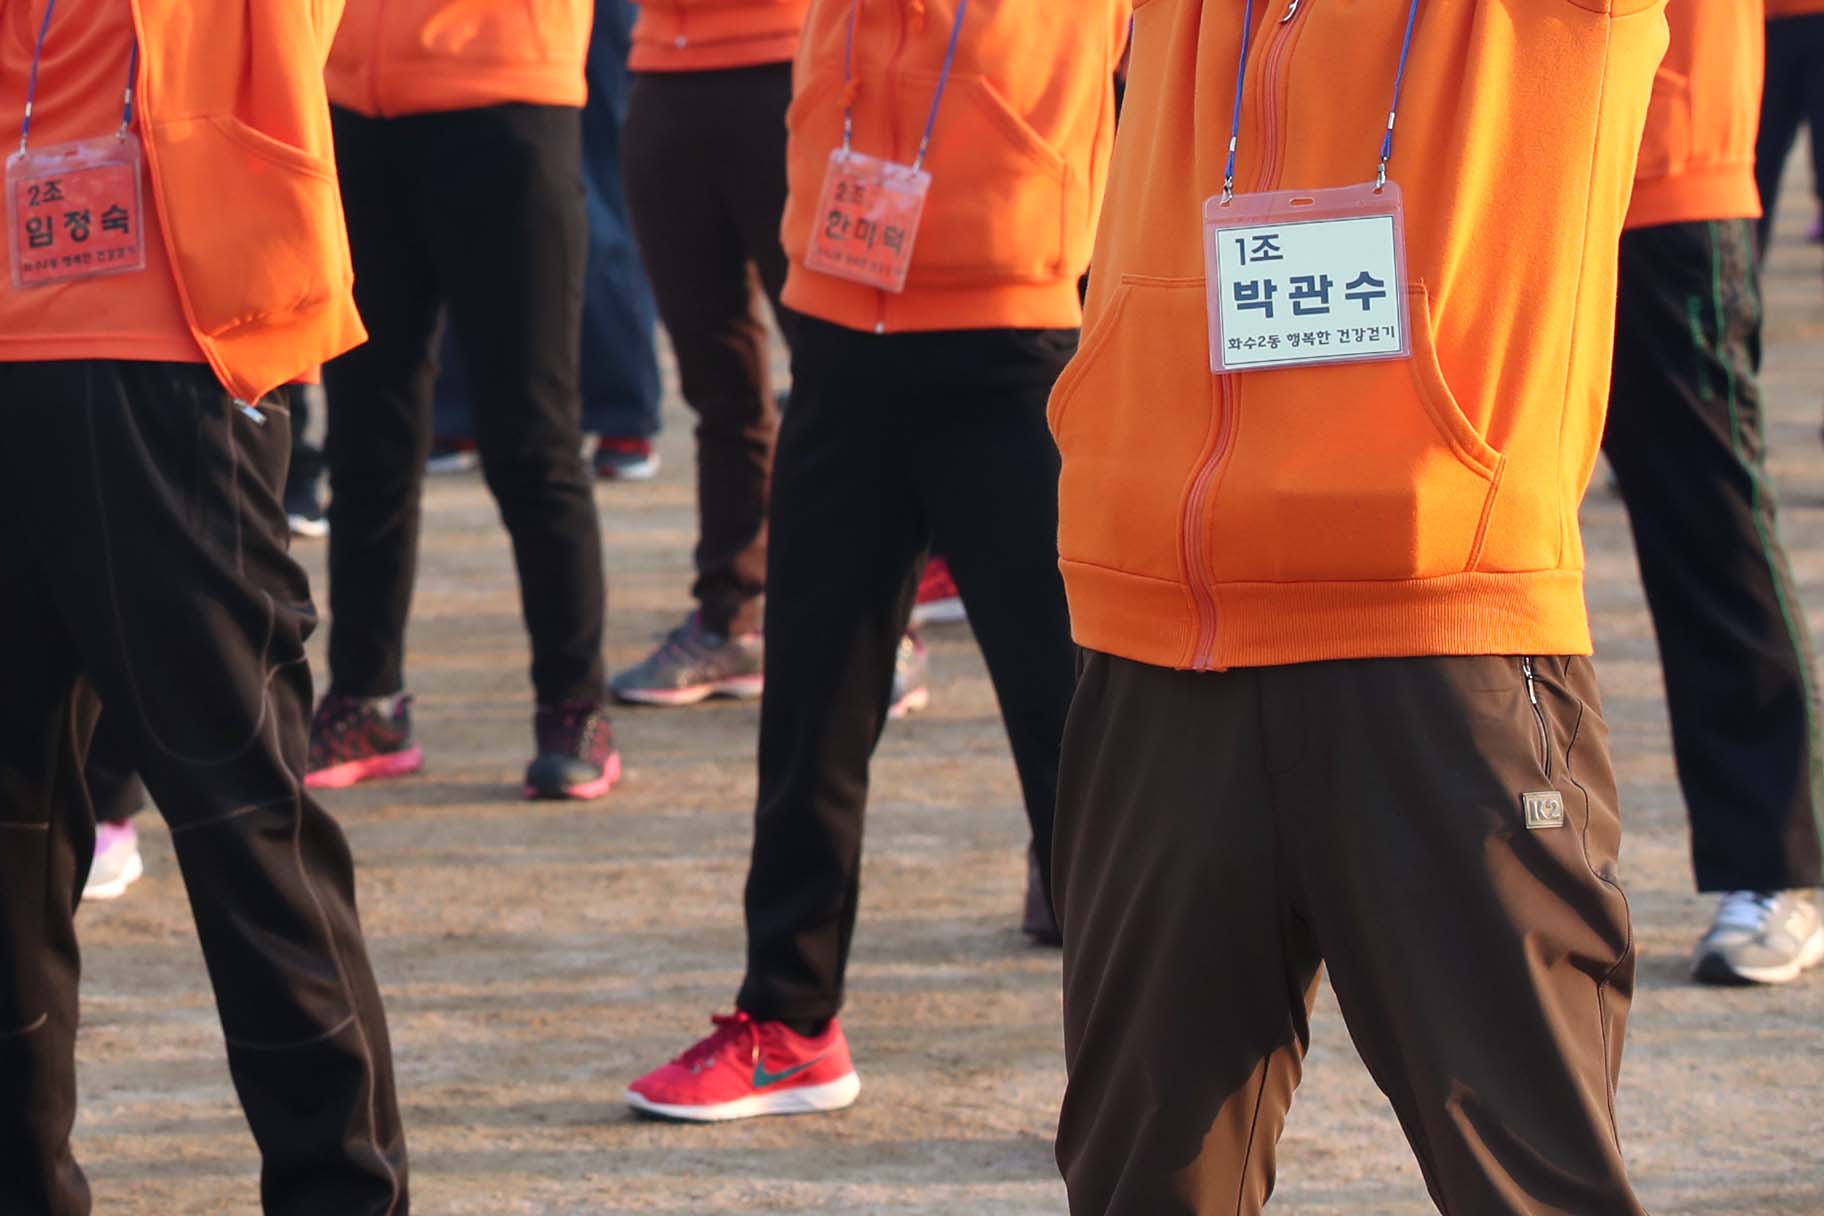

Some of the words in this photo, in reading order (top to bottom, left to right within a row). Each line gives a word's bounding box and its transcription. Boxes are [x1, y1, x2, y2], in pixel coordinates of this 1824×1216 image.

[27, 179, 64, 207] 2조
[25, 204, 129, 249] 임정숙
[1234, 234, 1284, 266] 1조
[1233, 271, 1387, 319] 박관수
[1227, 334, 1281, 350] 화수2동
[1286, 330, 1331, 348] 행복한
[1336, 325, 1396, 344] 건강걷기
[1528, 799, 1561, 821] K2
